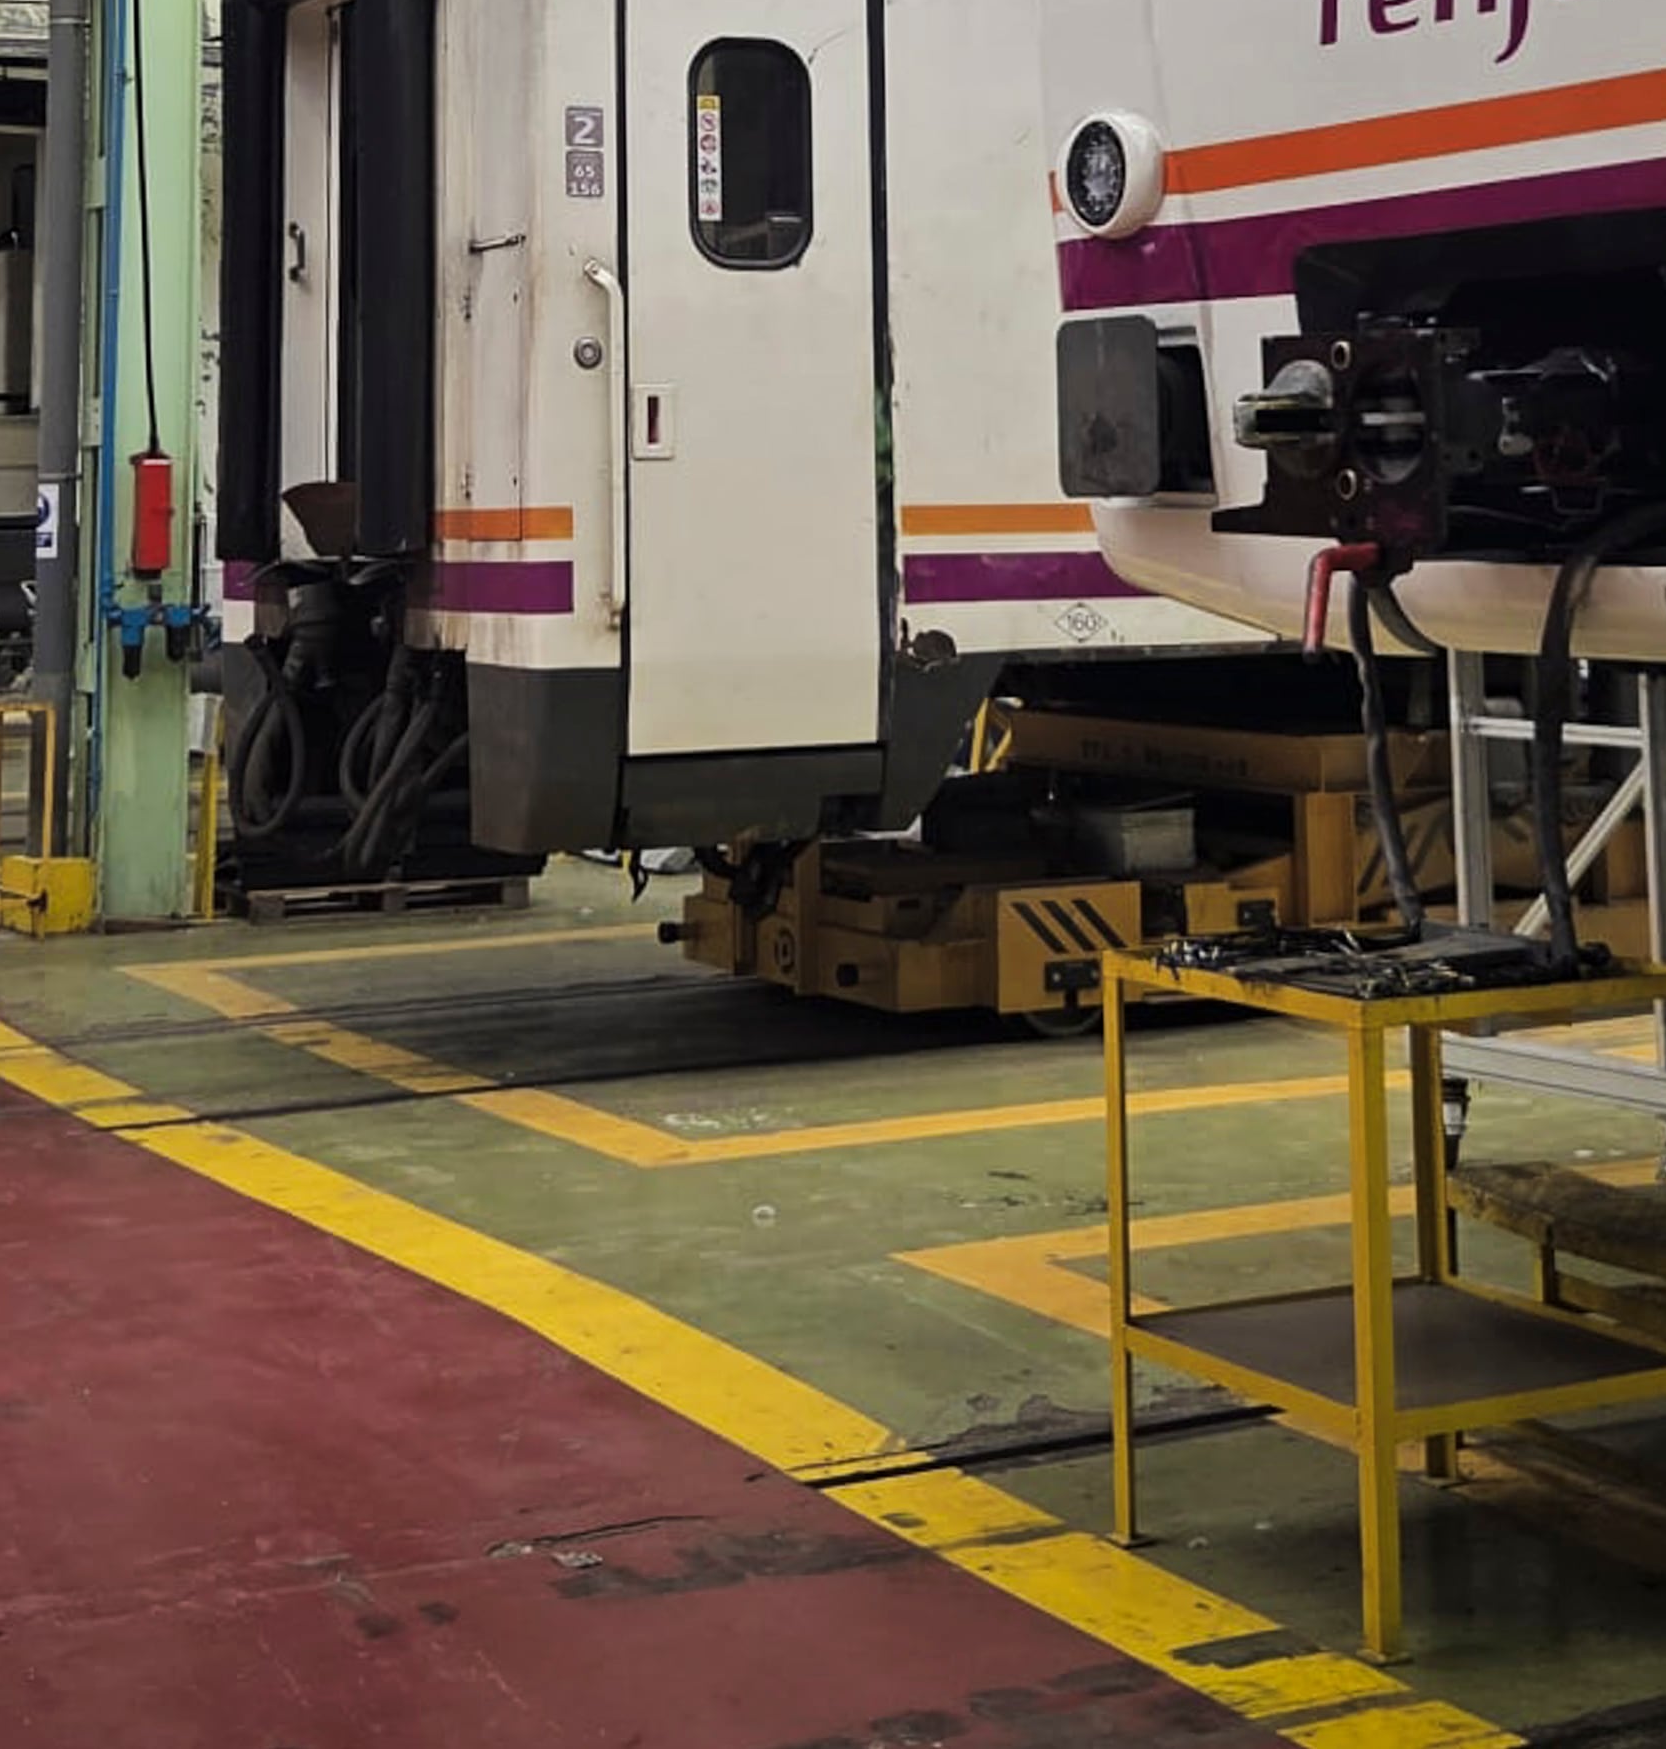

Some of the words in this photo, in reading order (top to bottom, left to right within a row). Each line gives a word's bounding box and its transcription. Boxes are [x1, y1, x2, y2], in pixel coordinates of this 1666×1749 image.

[573, 116, 596, 144] 2
[574, 164, 595, 178] 65
[570, 181, 601, 195] 156
